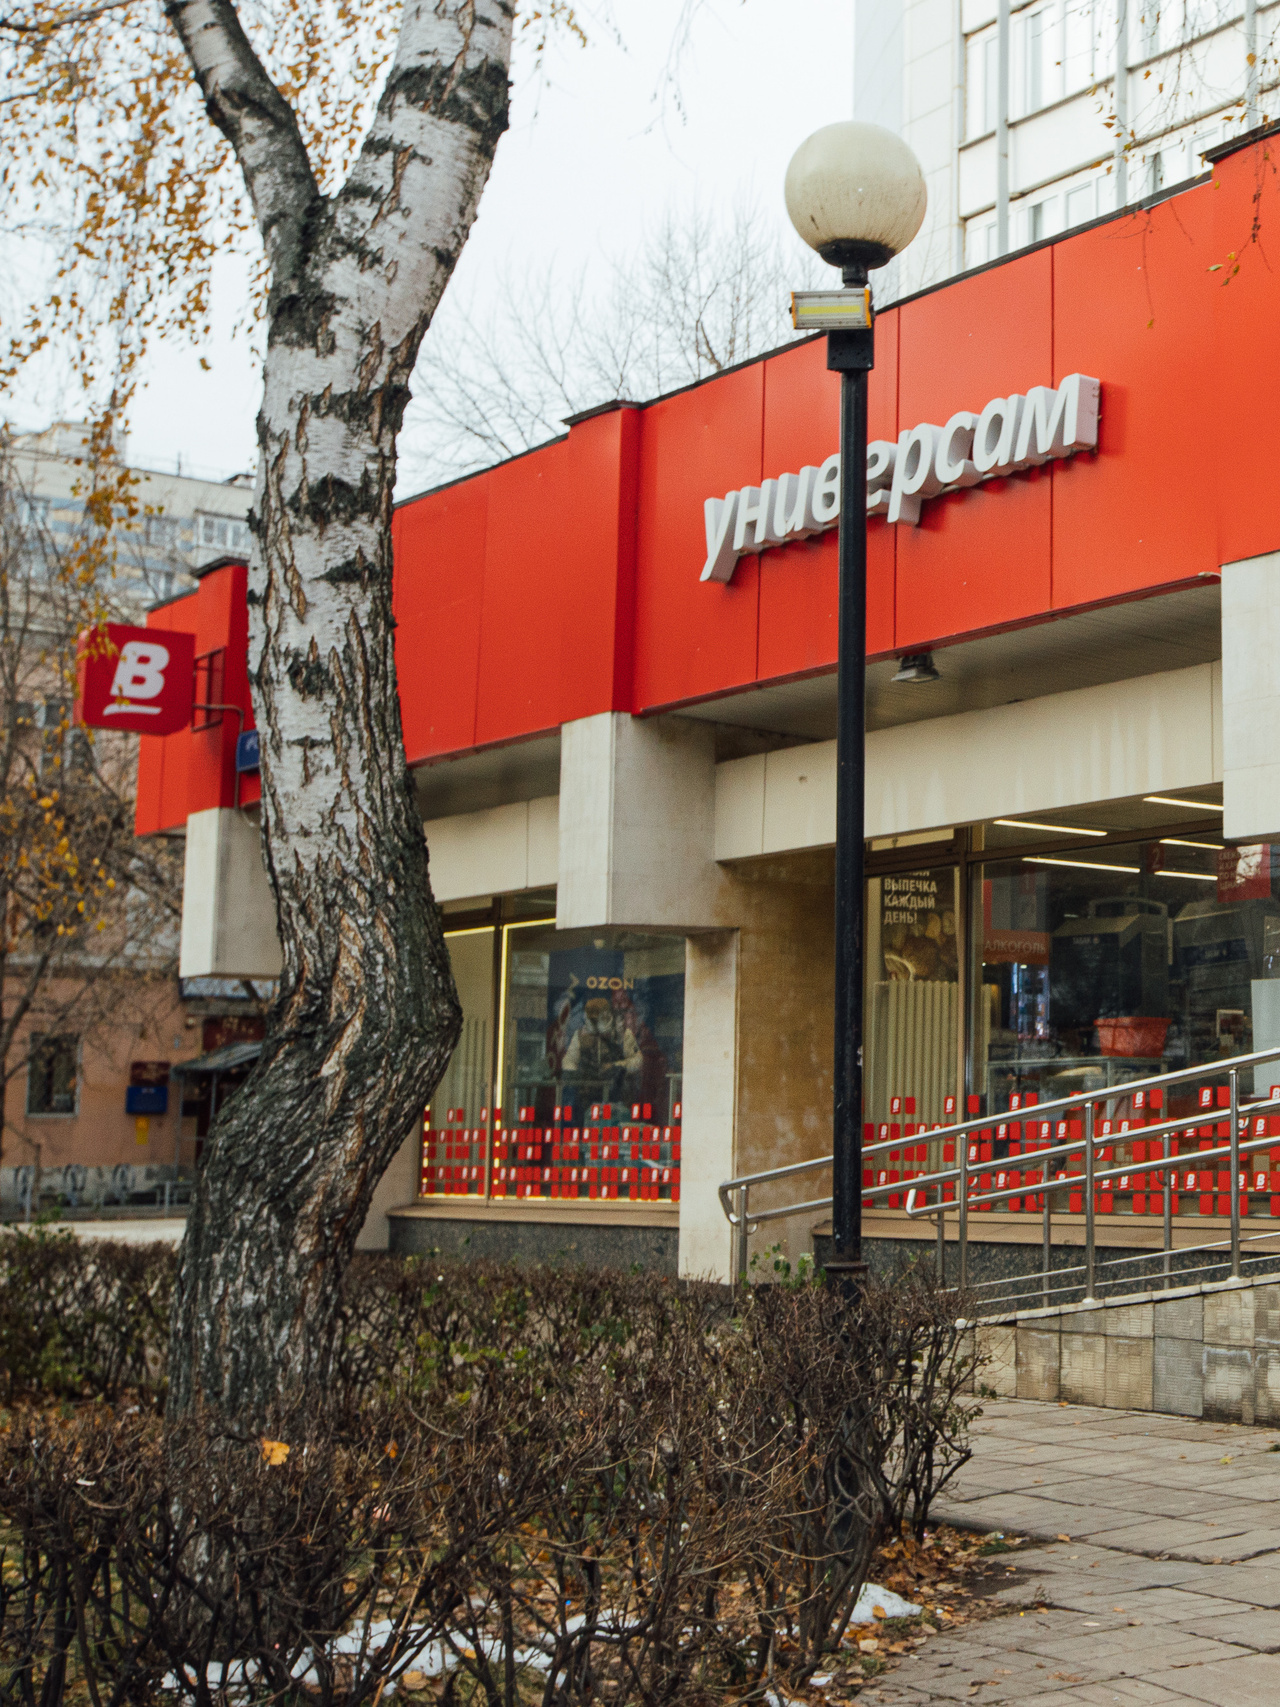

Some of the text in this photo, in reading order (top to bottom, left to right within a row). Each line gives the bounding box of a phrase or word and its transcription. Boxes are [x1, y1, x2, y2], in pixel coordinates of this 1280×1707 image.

[699, 373, 1099, 584] универсам
[110, 641, 170, 699] В
[884, 878, 938, 893] ВЫПЕЧКА
[884, 894, 936, 910] КАЖДЫЙ
[883, 911, 917, 925] ДЕНЬ!
[985, 940, 1046, 954] АЛКОГОЛЬ
[586, 976, 634, 990] OZON
